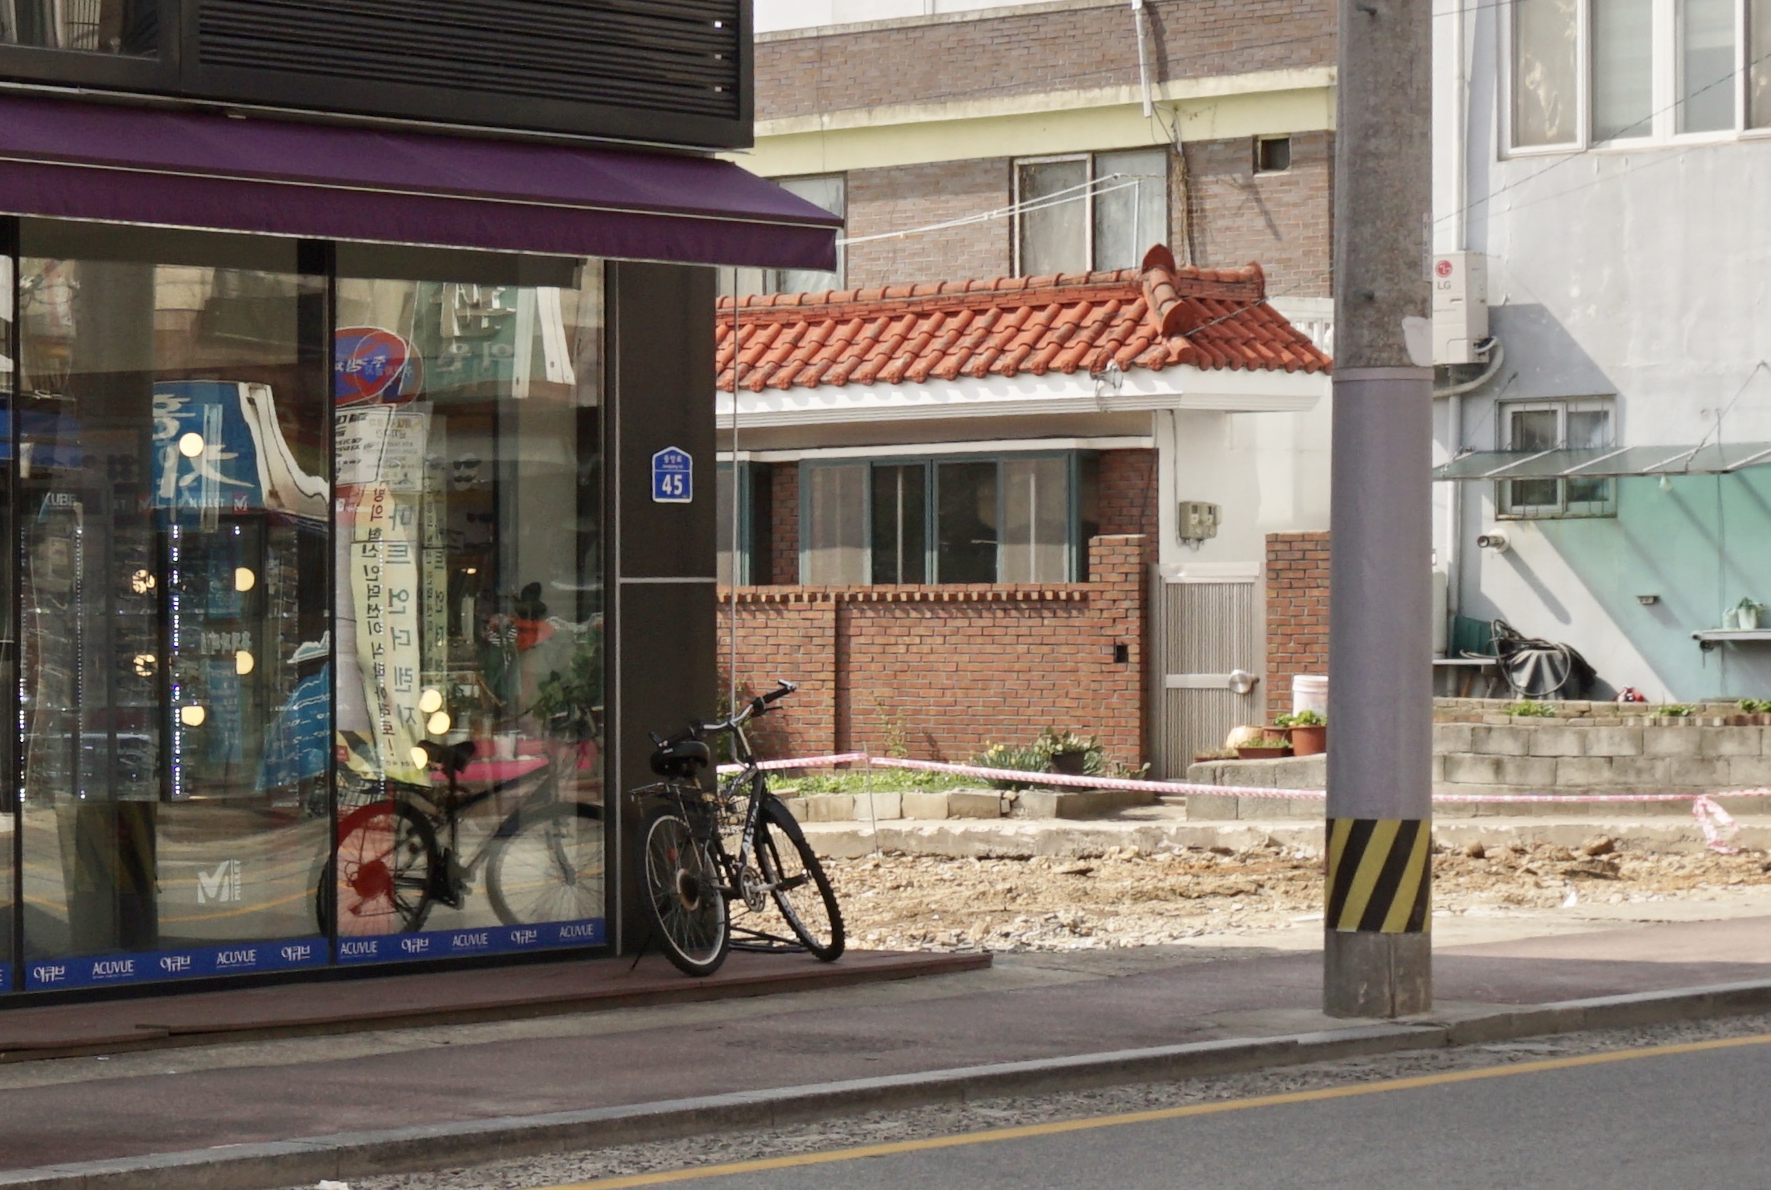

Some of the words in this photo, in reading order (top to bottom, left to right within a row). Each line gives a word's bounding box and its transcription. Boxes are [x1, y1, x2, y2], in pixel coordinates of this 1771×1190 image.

[1437, 281, 1451, 290] LG
[661, 474, 683, 495] 45
[559, 923, 594, 938] ACUVUE
[451, 932, 489, 947] ACUVUE
[340, 940, 378, 955] ACUVUE
[215, 949, 257, 965] ACUVUE
[91, 959, 135, 975] ACUVUE
